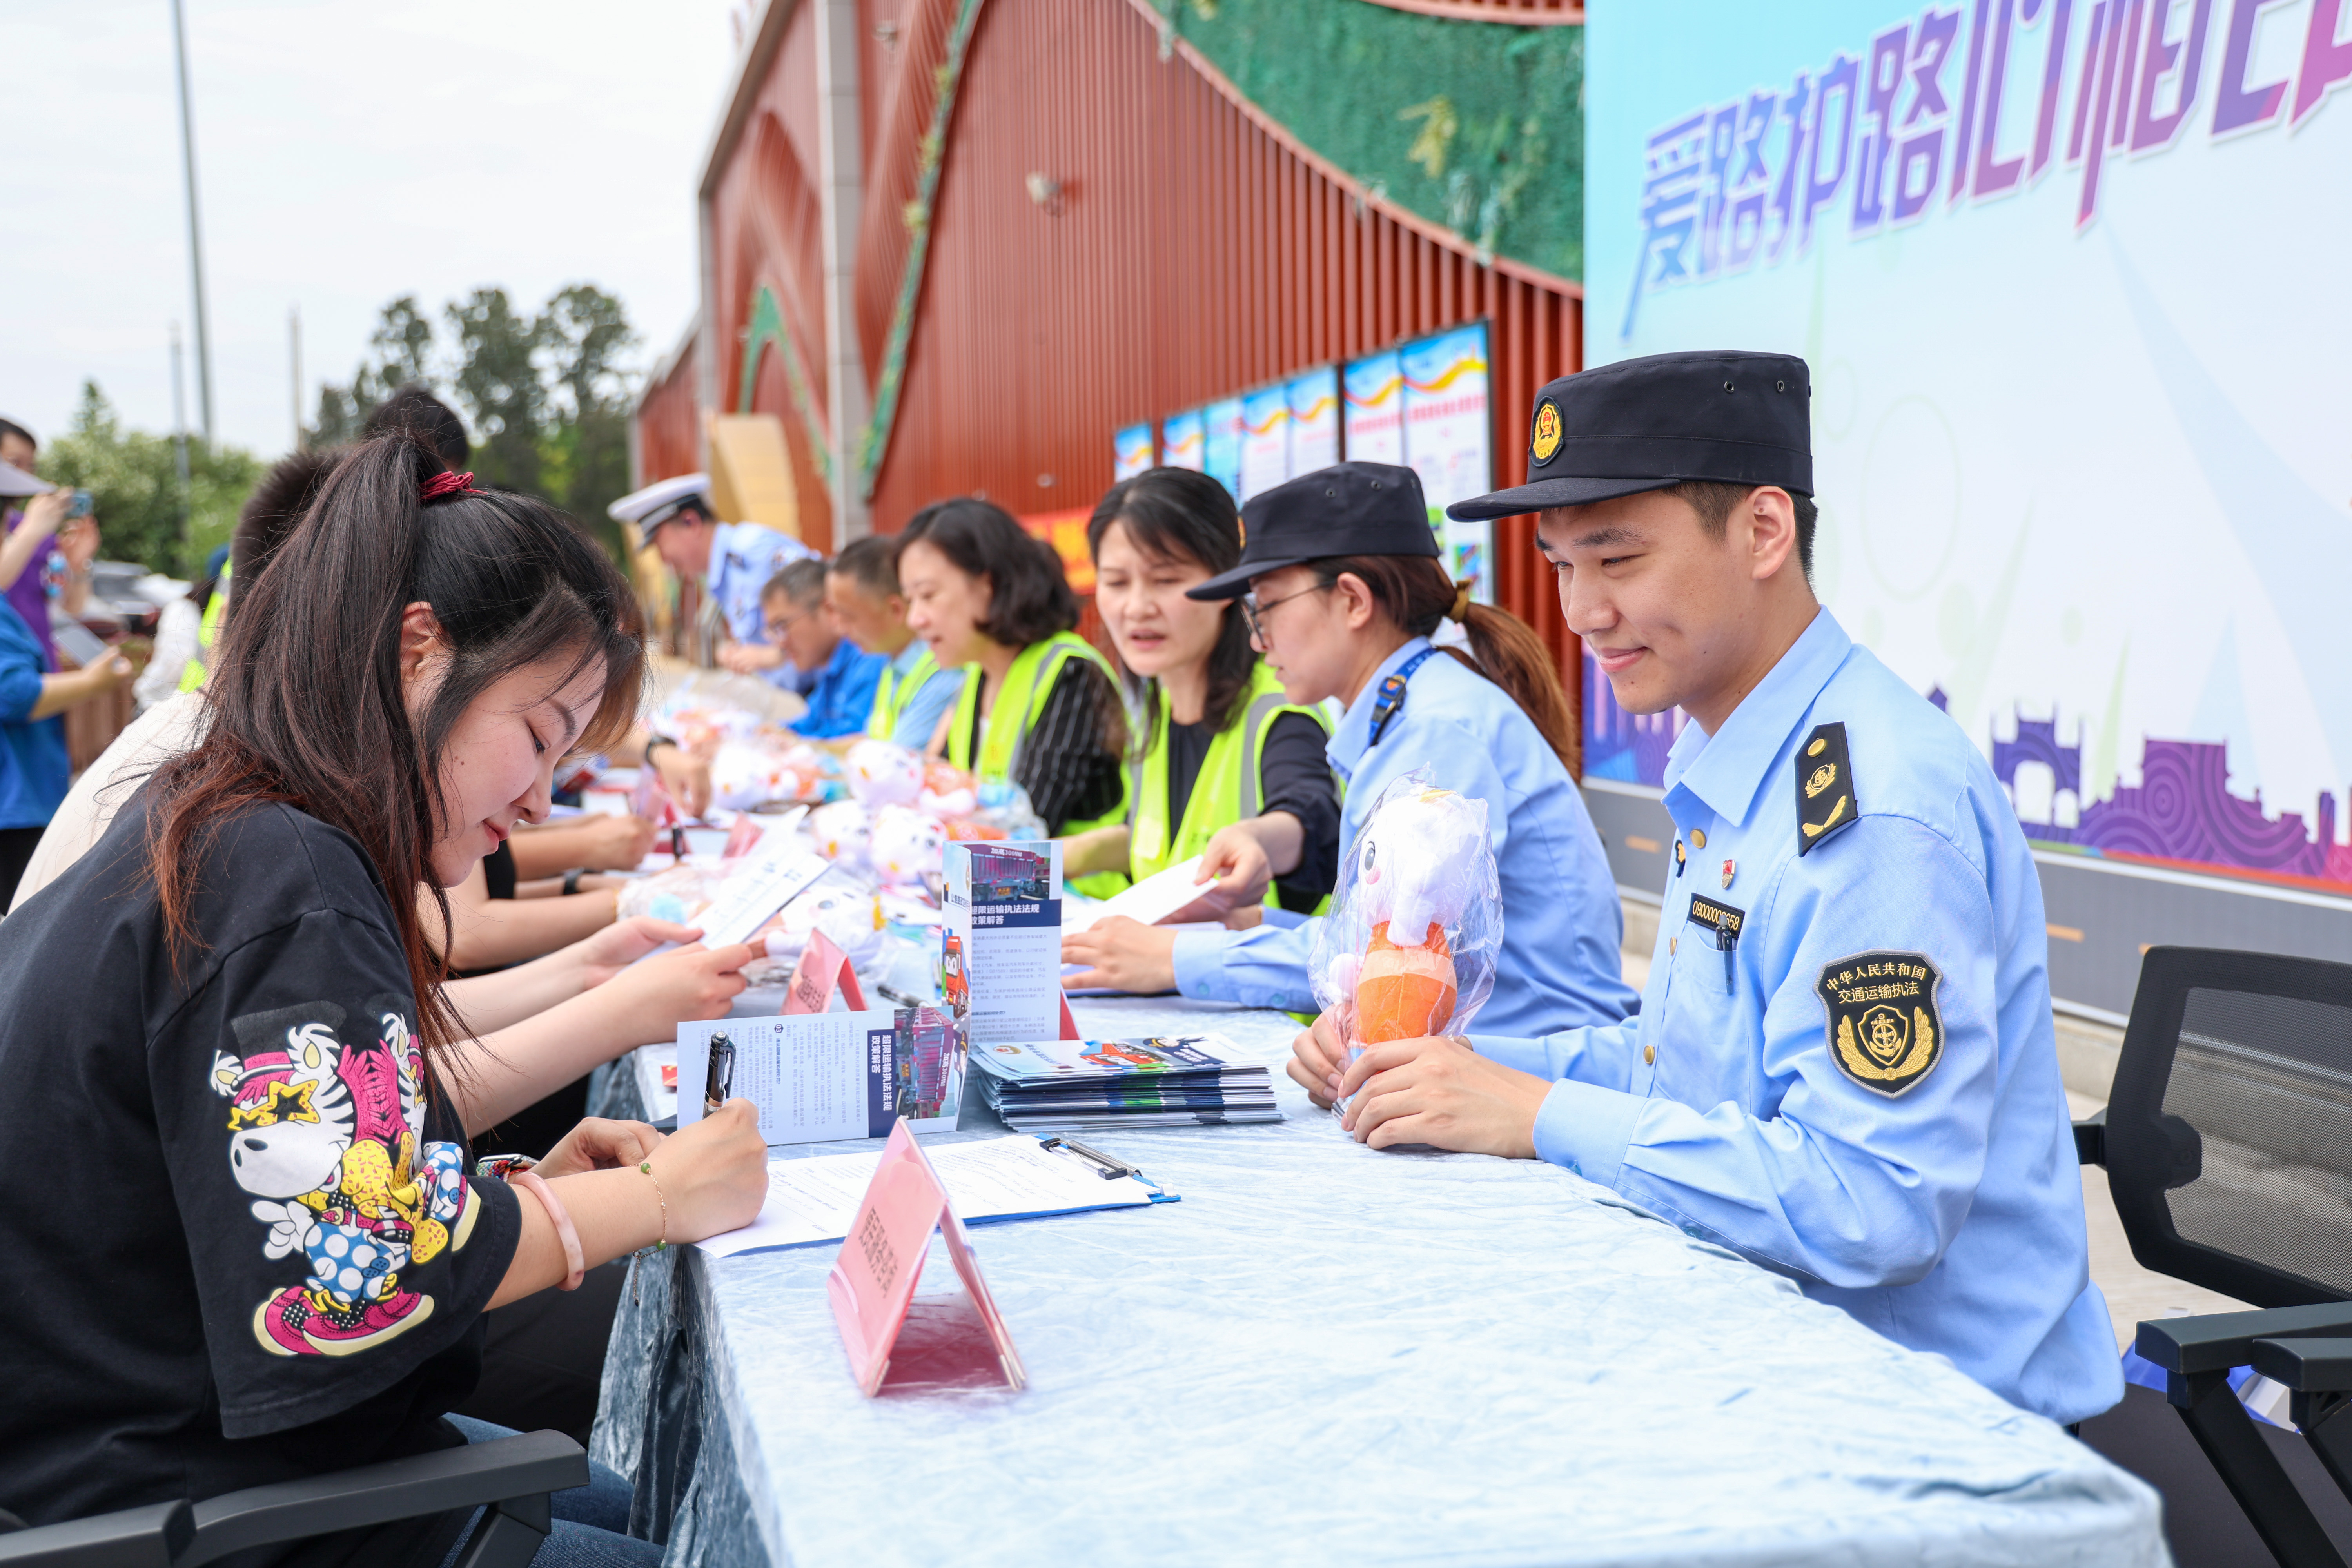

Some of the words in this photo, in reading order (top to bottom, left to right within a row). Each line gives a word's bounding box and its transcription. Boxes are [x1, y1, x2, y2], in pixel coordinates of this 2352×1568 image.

[1826, 962, 1926, 991] 中华人民共和国
[1838, 981, 1919, 1004] 交通运输执法
[871, 1035, 880, 1073] 政策解答
[882, 1035, 892, 1111] 超限运输执法法规
